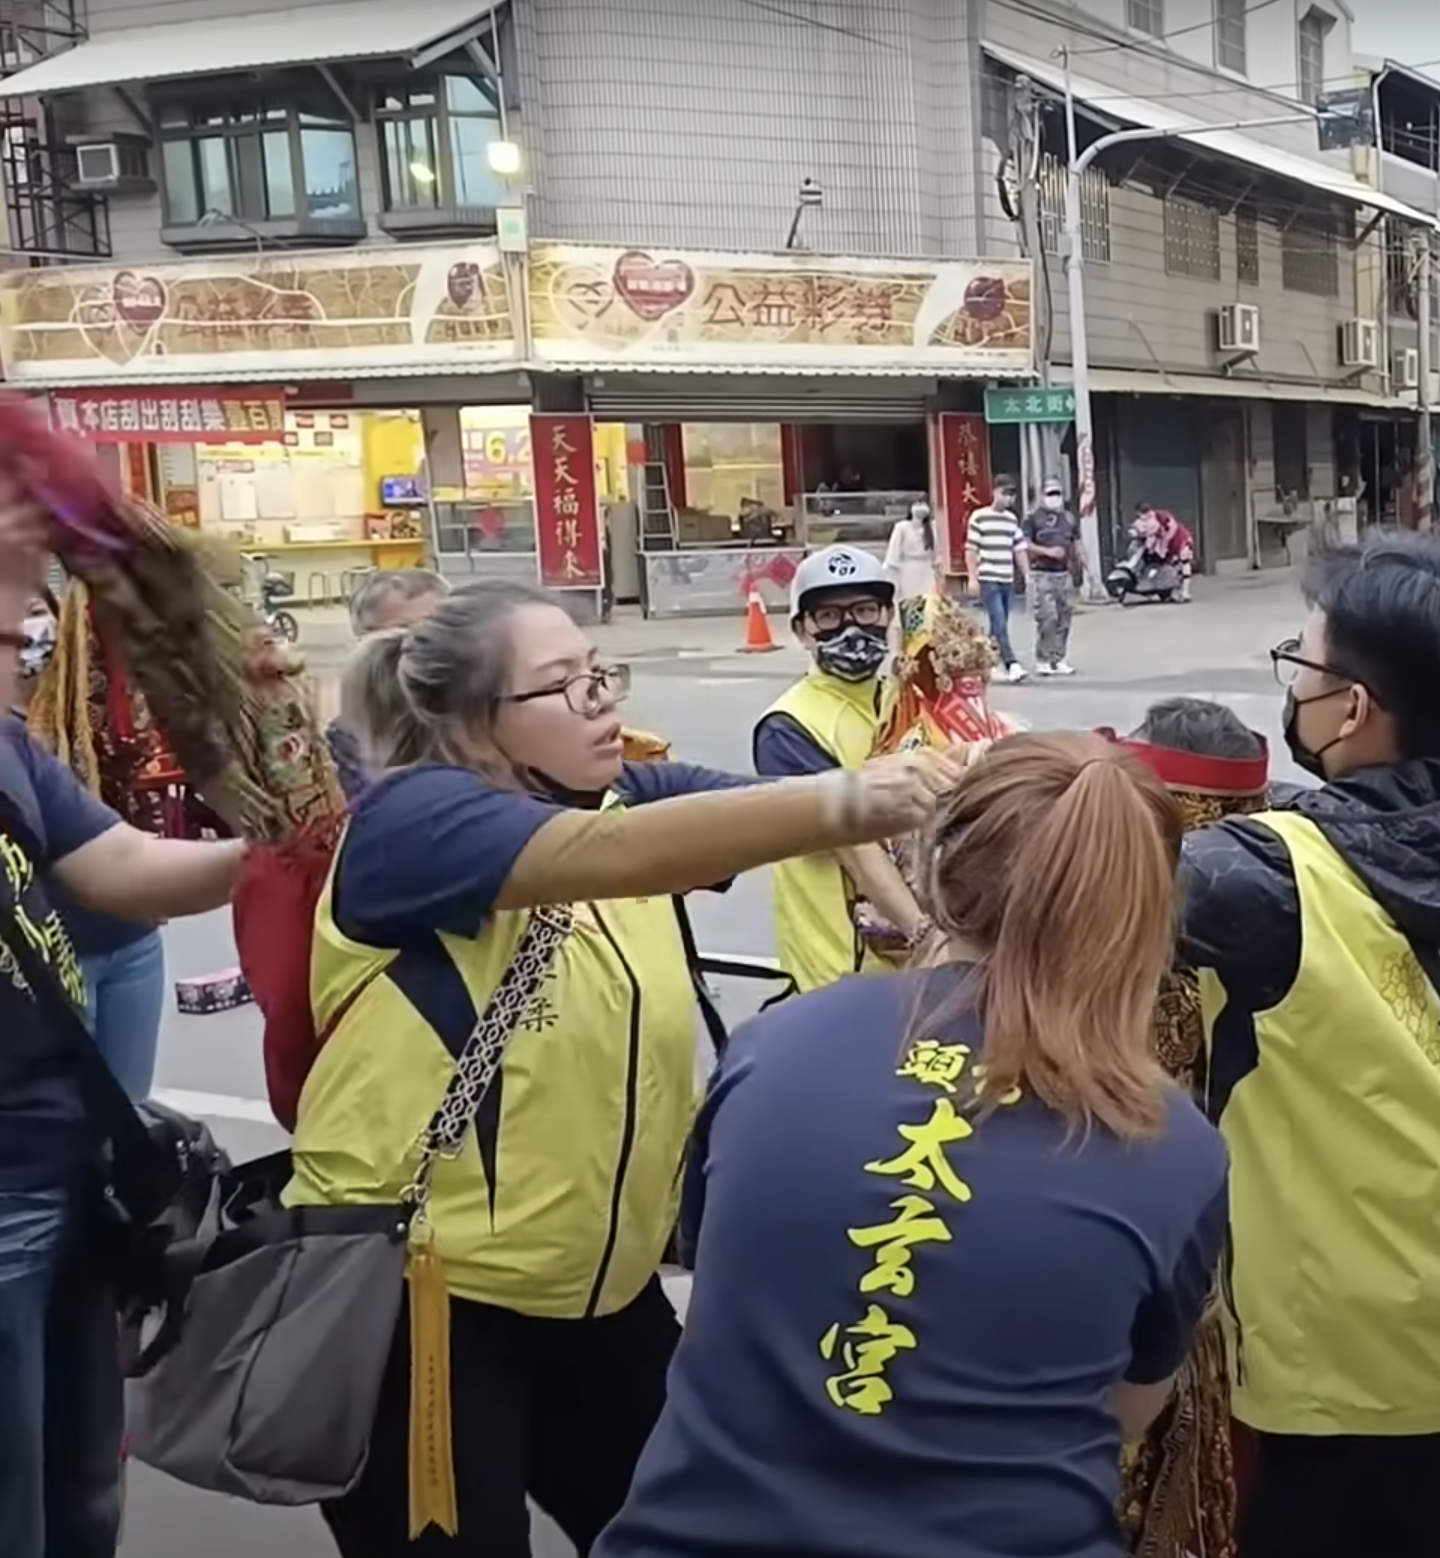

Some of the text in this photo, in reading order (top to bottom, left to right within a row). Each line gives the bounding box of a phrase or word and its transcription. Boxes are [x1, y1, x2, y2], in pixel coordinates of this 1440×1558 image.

[702, 277, 894, 333] 公益彩券
[551, 424, 586, 580] 天天福得來
